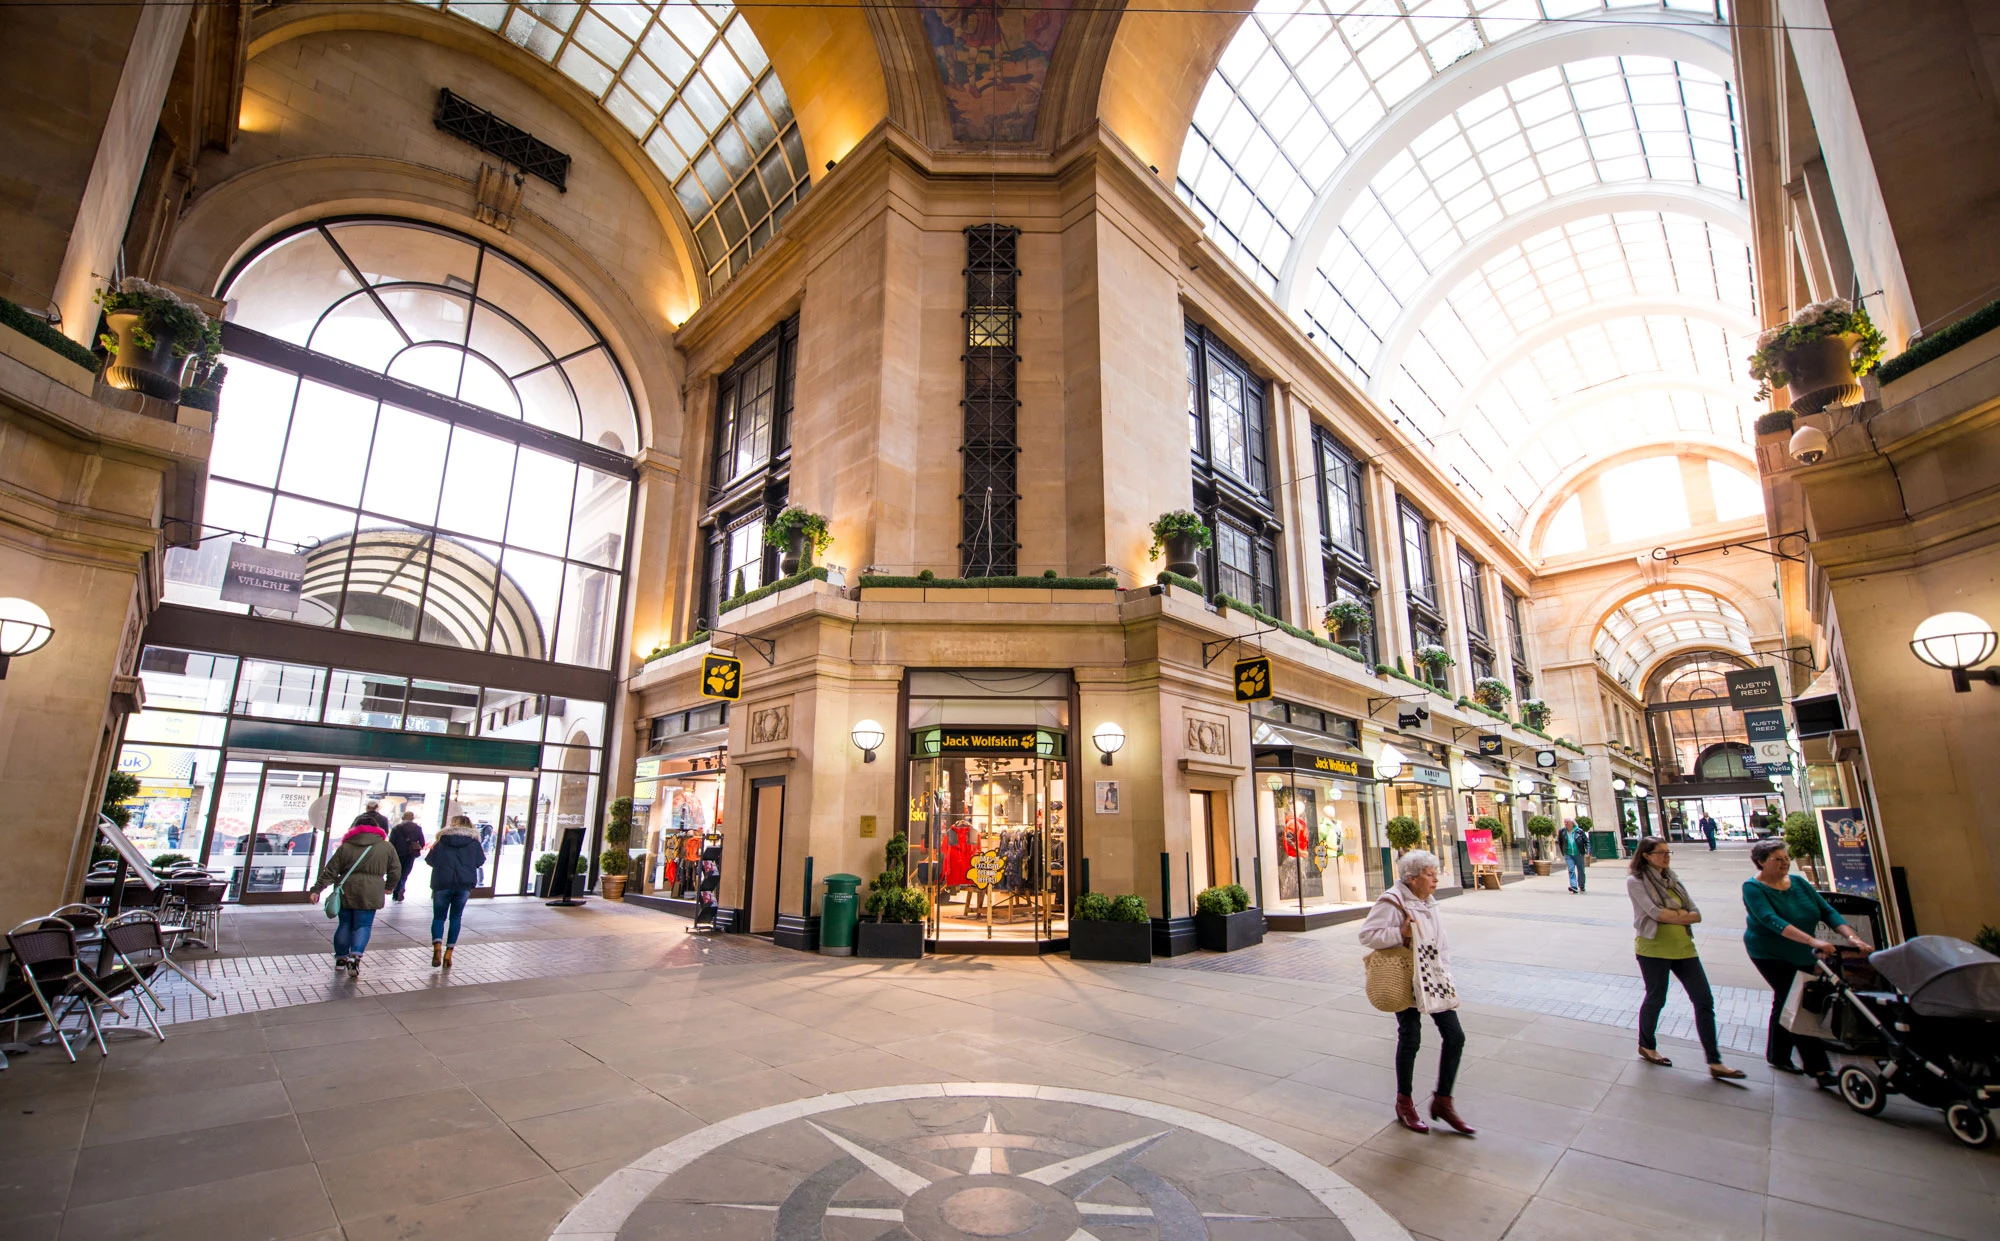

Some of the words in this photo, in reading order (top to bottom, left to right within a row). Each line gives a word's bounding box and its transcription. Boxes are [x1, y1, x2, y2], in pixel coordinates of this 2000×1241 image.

[231, 561, 301, 581] PATISSERIE
[238, 575, 290, 592] VALERIE
[1735, 681, 1771, 690] AUSTIN
[1740, 688, 1767, 696] REED
[942, 735, 969, 747] Jack
[972, 735, 1019, 747] Wolfskin
[1315, 756, 1329, 769] Jack
[1328, 758, 1351, 773] Wolfskin
[280, 793, 311, 801] FRESHLY
[283, 800, 307, 808] BAKED
